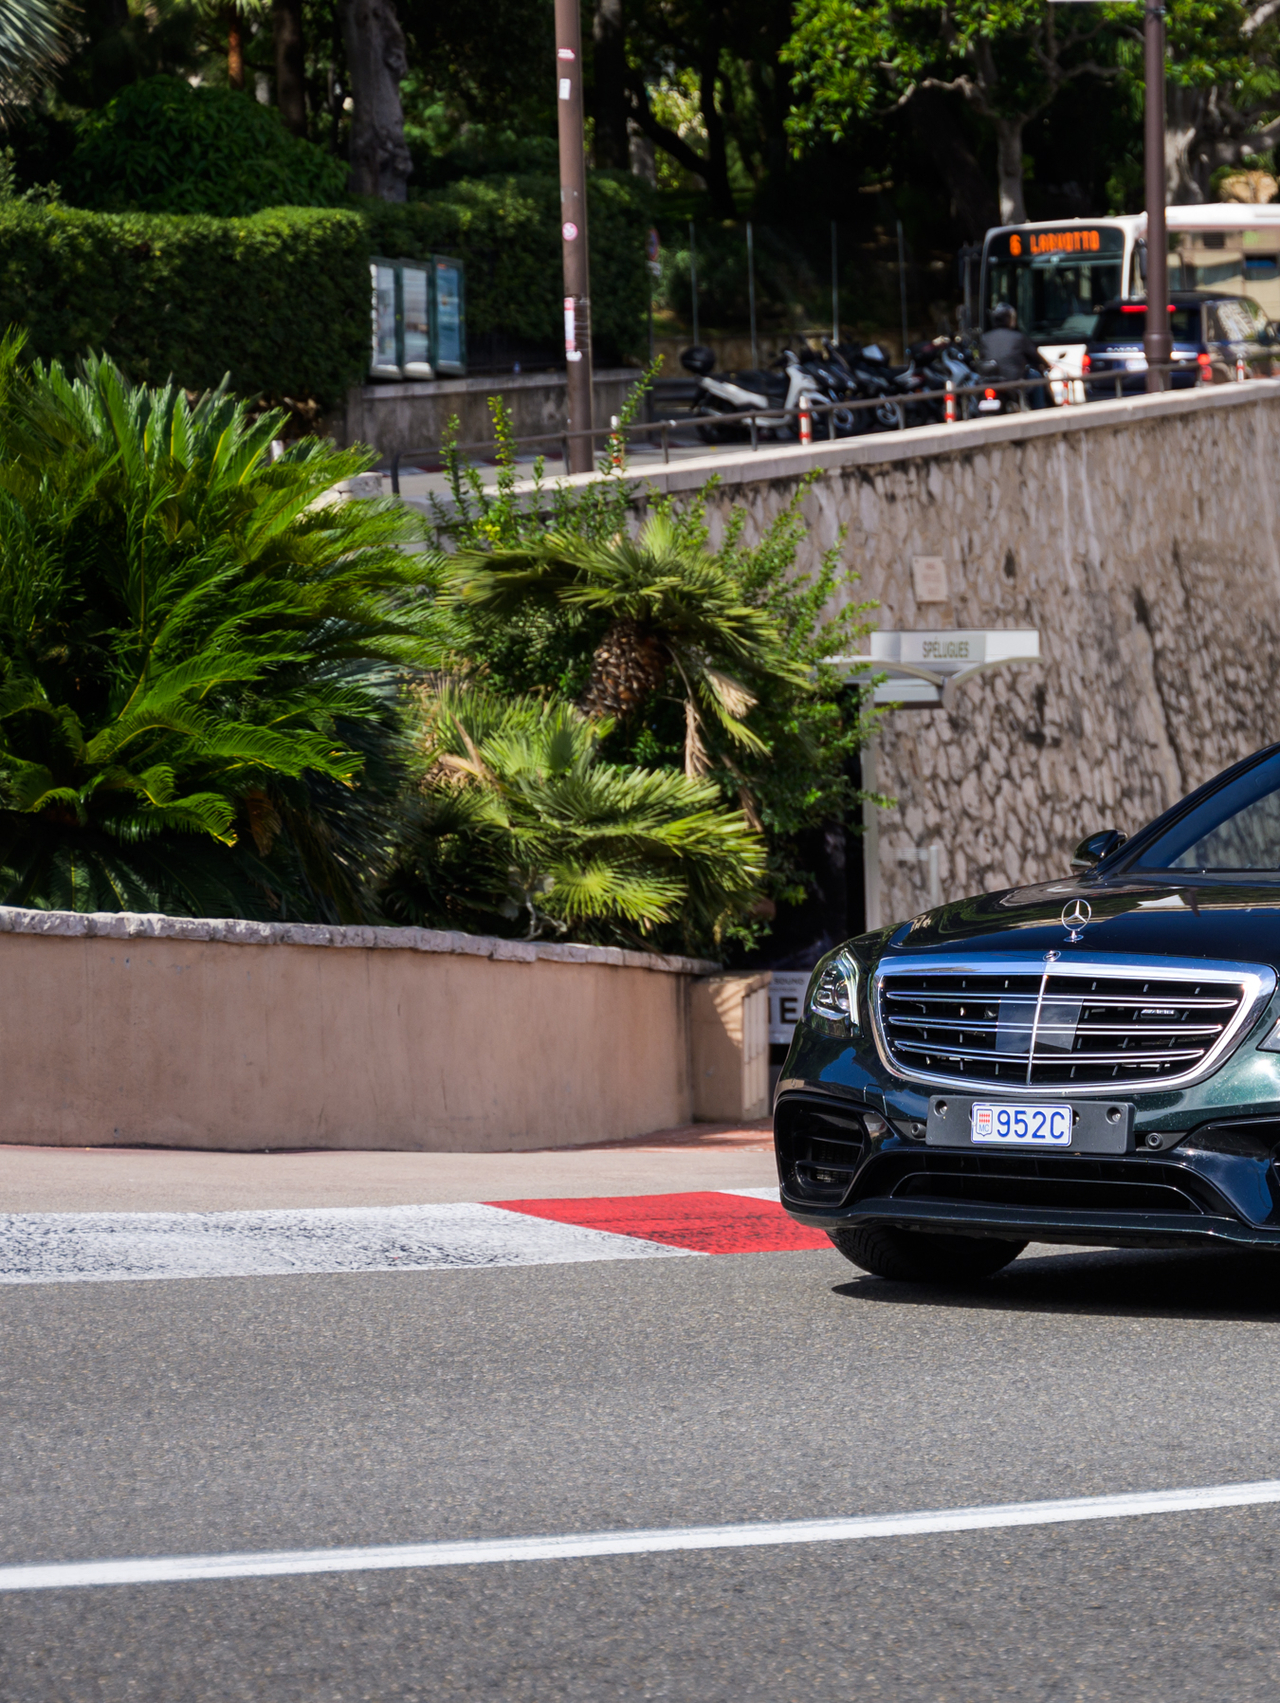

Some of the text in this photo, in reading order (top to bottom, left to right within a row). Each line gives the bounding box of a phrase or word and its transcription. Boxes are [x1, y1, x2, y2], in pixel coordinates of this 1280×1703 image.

[1009, 234, 1022, 257] 6
[978, 1124, 990, 1133] MC
[996, 1109, 1065, 1139] 952C
